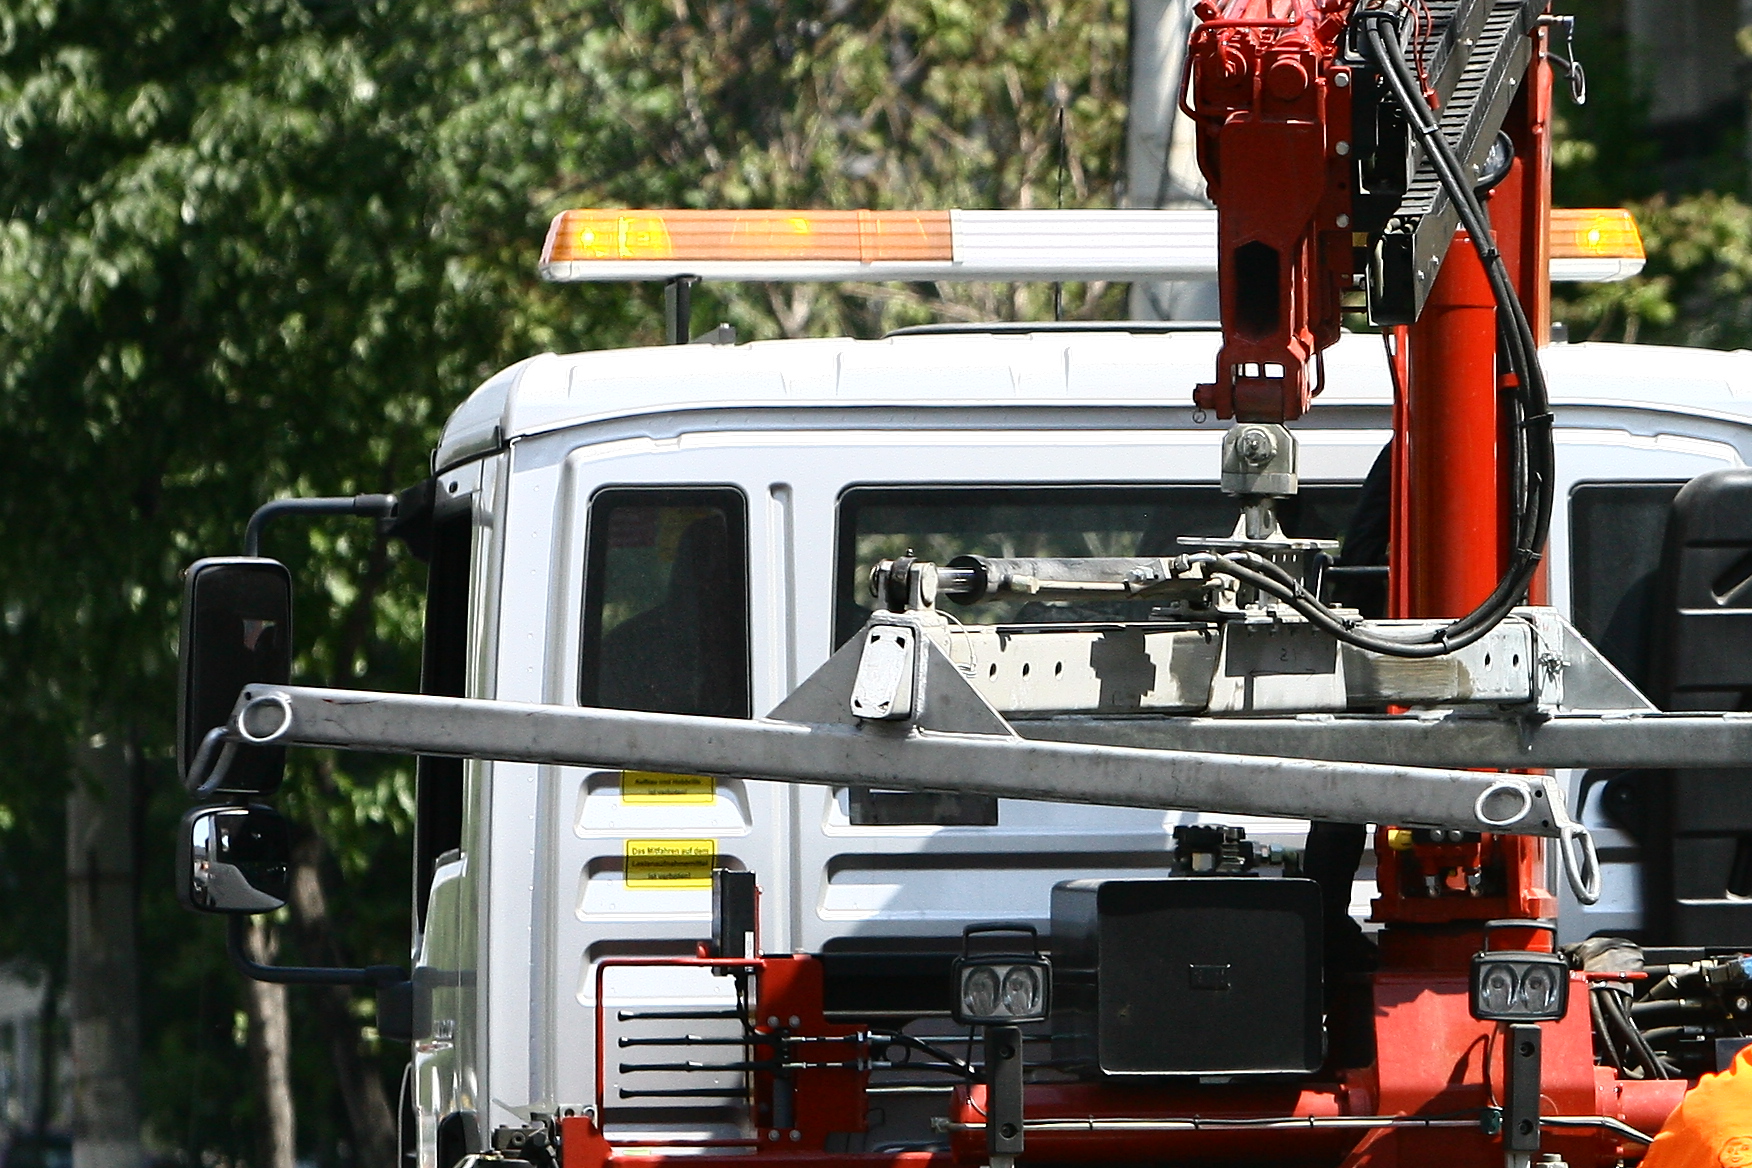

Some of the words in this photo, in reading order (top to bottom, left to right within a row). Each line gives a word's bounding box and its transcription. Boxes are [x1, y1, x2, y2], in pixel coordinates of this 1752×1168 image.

[632, 847, 645, 856] Das
[647, 846, 680, 856] Mitfahren
[681, 846, 693, 856] auf
[694, 847, 709, 856] dem
